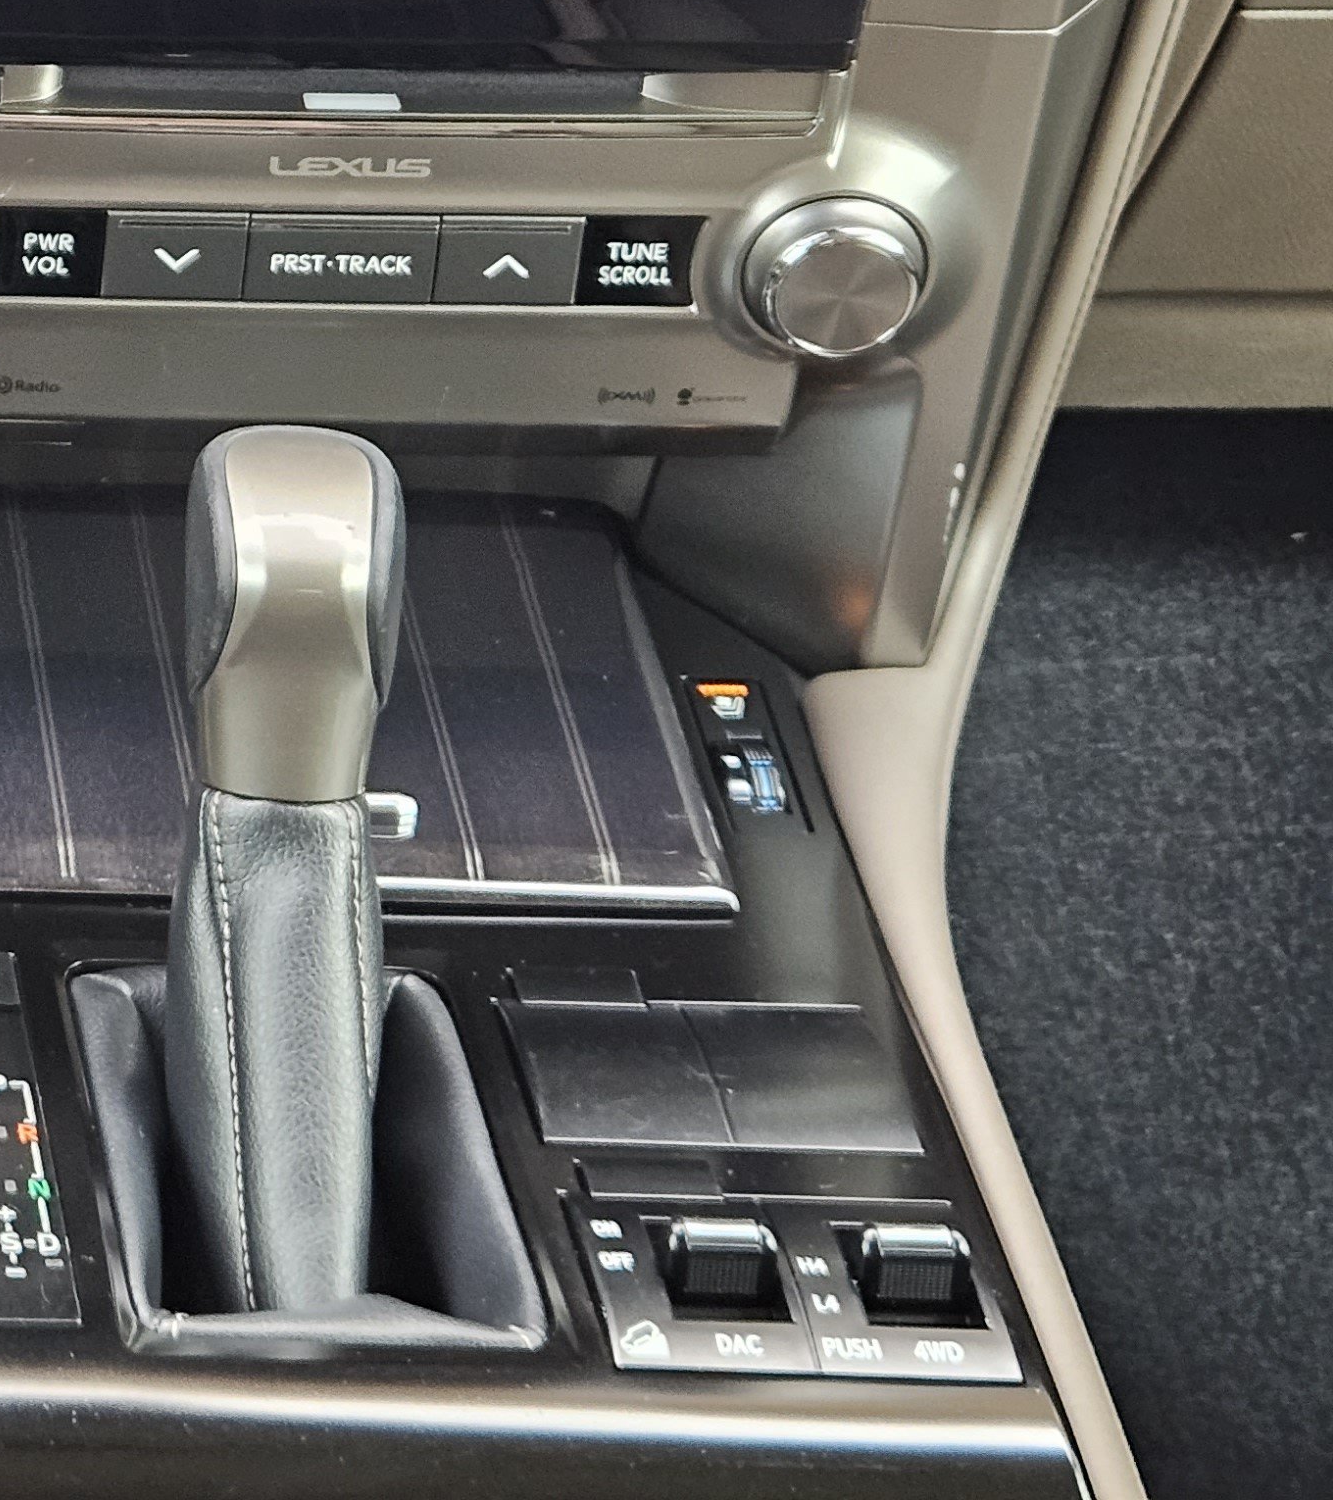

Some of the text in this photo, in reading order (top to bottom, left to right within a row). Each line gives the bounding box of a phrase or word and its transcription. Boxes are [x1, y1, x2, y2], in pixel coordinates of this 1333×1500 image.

[268, 155, 433, 179] LEXUS
[22, 232, 76, 256] PWR
[606, 241, 670, 264] TUNE
[22, 255, 71, 277] VOL
[598, 265, 672, 287] SCROLL
[17, 1122, 39, 1145] R
[27, 1178, 52, 1201] N
[589, 1218, 624, 1239] ON
[0, 1231, 23, 1256] S
[36, 1231, 62, 1257] D
[597, 1250, 636, 1273] OFF
[714, 1332, 765, 1357] DAC
[821, 1337, 965, 1364] PUSH 4WD
